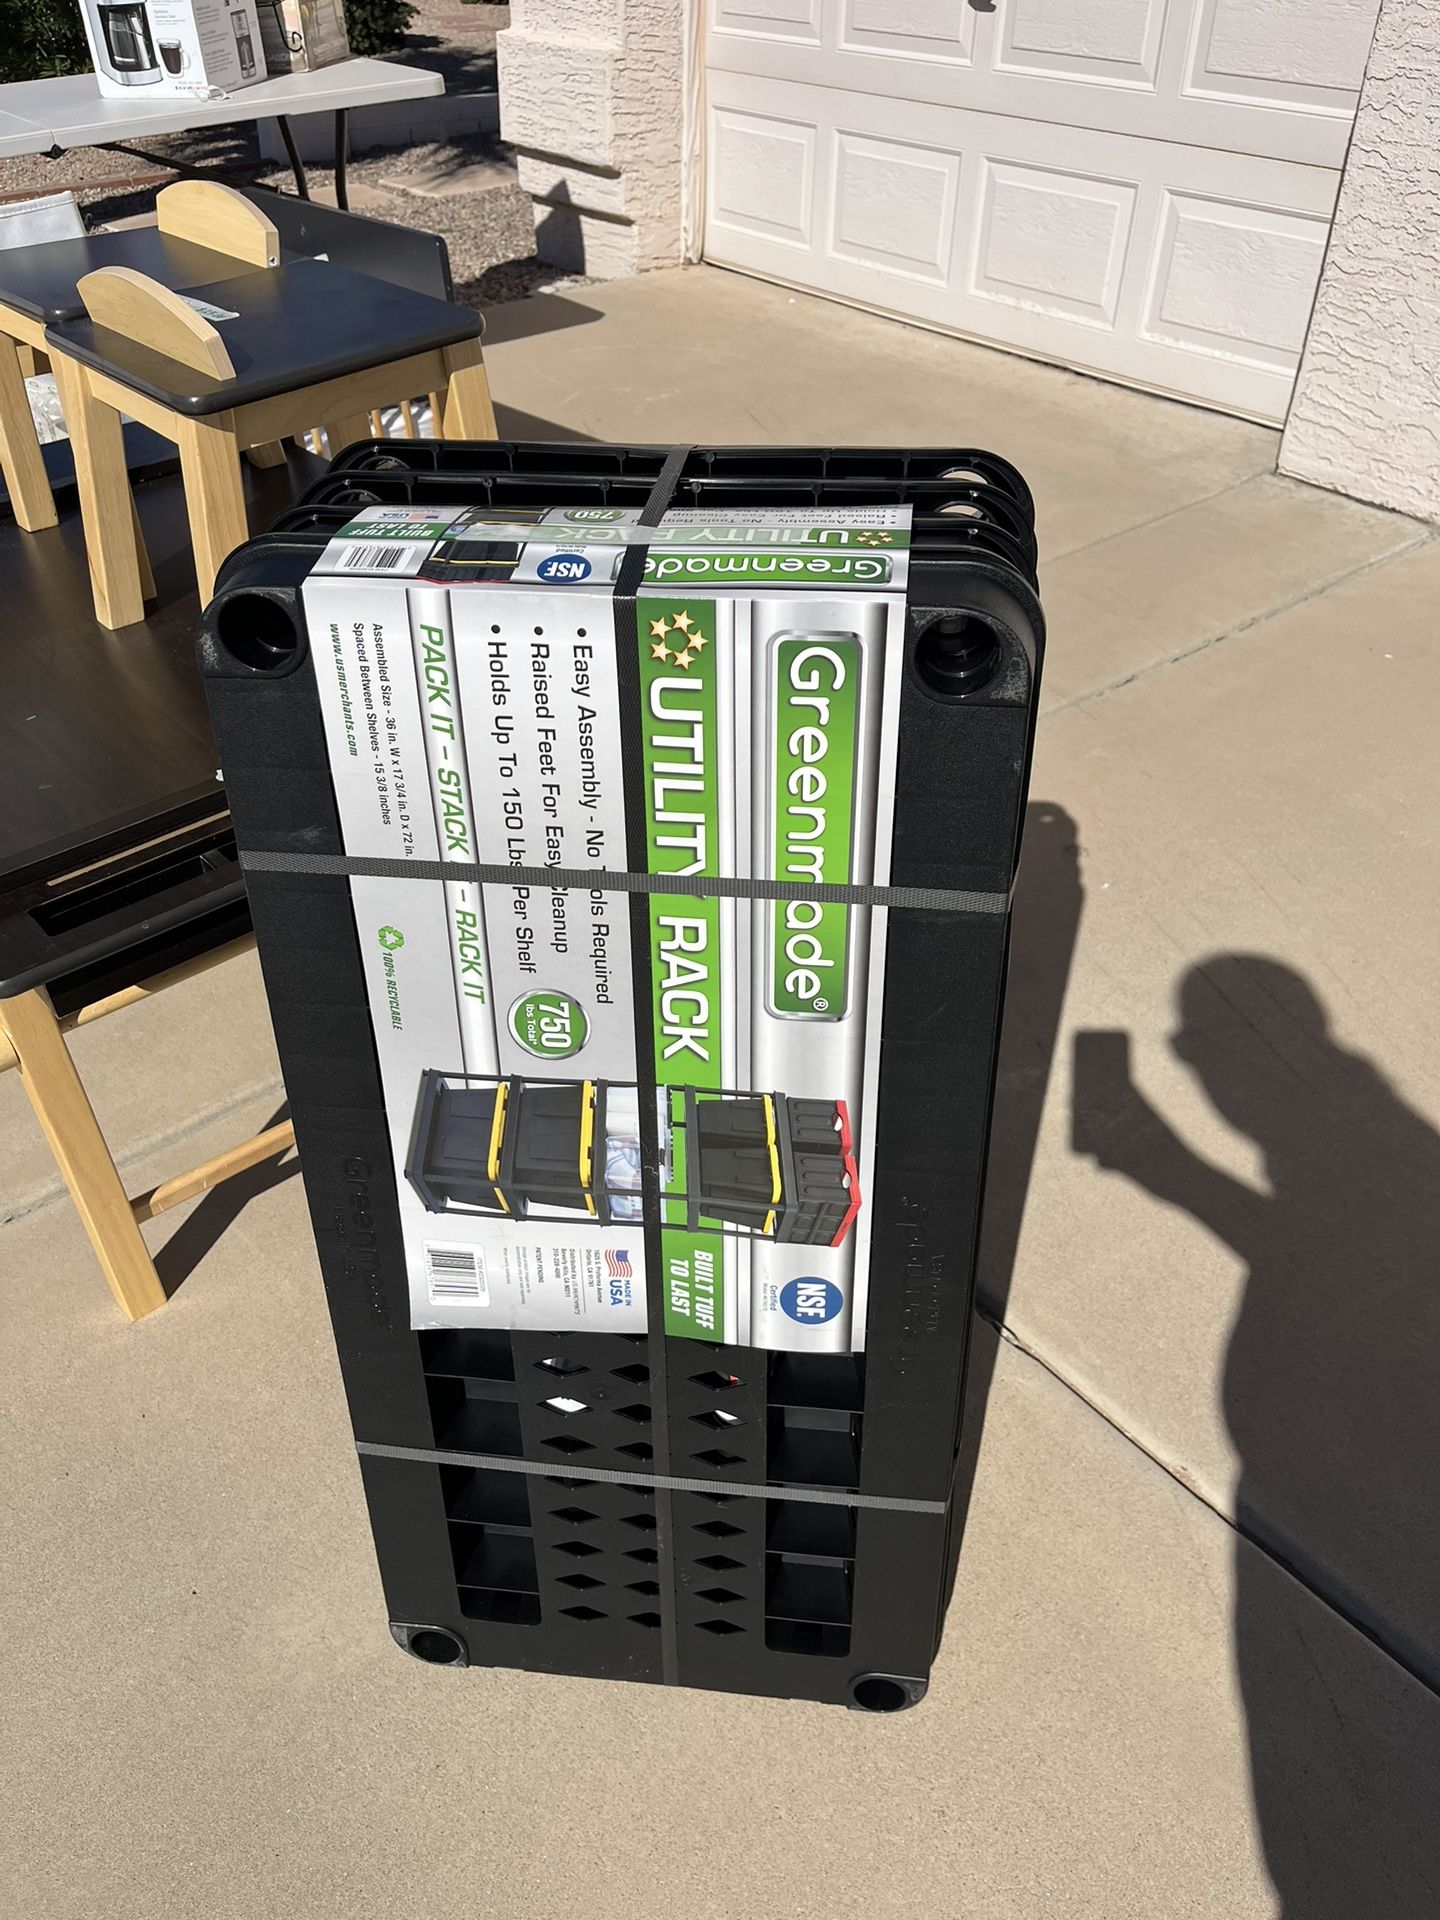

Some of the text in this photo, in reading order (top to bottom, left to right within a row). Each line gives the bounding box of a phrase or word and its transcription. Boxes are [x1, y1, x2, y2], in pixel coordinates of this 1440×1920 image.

[574, 510, 614, 519] 750
[348, 528, 434, 537] BUILT TUFF
[688, 528, 849, 543] UTILITY
[352, 622, 369, 662] Spaced
[372, 623, 391, 682] Assembled
[420, 623, 452, 707] PACK
[488, 641, 511, 706] Holds
[530, 642, 555, 719] Raised
[570, 644, 593, 697] Easy
[329, 623, 359, 756] www.usmerchants.com
[360, 665, 374, 710] Between
[380, 685, 393, 707] Size
[366, 713, 380, 752] Shelves
[385, 717, 397, 730] 36
[387, 732, 398, 744] in.
[430, 713, 455, 740] IT
[491, 715, 514, 745] Up
[374, 762, 385, 774] 15
[390, 747, 401, 757] W
[498, 752, 518, 778] To
[537, 728, 557, 775] Feet
[577, 705, 602, 809] Assembly
[376, 776, 388, 792] 3/8
[393, 768, 403, 780] 17
[394, 782, 407, 798] 3/4
[379, 794, 392, 825] inches
[397, 800, 408, 812] in.
[437, 767, 470, 856] STACK
[502, 787, 524, 830] 150
[542, 783, 561, 818] For
[402, 832, 413, 843] 72
[404, 845, 415, 857] in.
[544, 825, 564, 870] Easy
[586, 829, 605, 858] No
[512, 885, 530, 920] Per
[588, 865, 609, 916] ols
[455, 908, 483, 977] RACK
[515, 926, 537, 974] Shelf
[589, 923, 614, 1004] Required
[382, 951, 403, 1031] 100% RECYCLABLE
[463, 982, 486, 1005] IT
[658, 915, 709, 1061] RACK
[525, 1003, 535, 1017] lbs
[538, 1001, 572, 1048] 750
[609, 1279, 622, 1306] USA
[670, 1258, 690, 1317] TO LAST
[693, 1250, 714, 1330] BUILT TUFF
[769, 1285, 778, 1311] Certified
